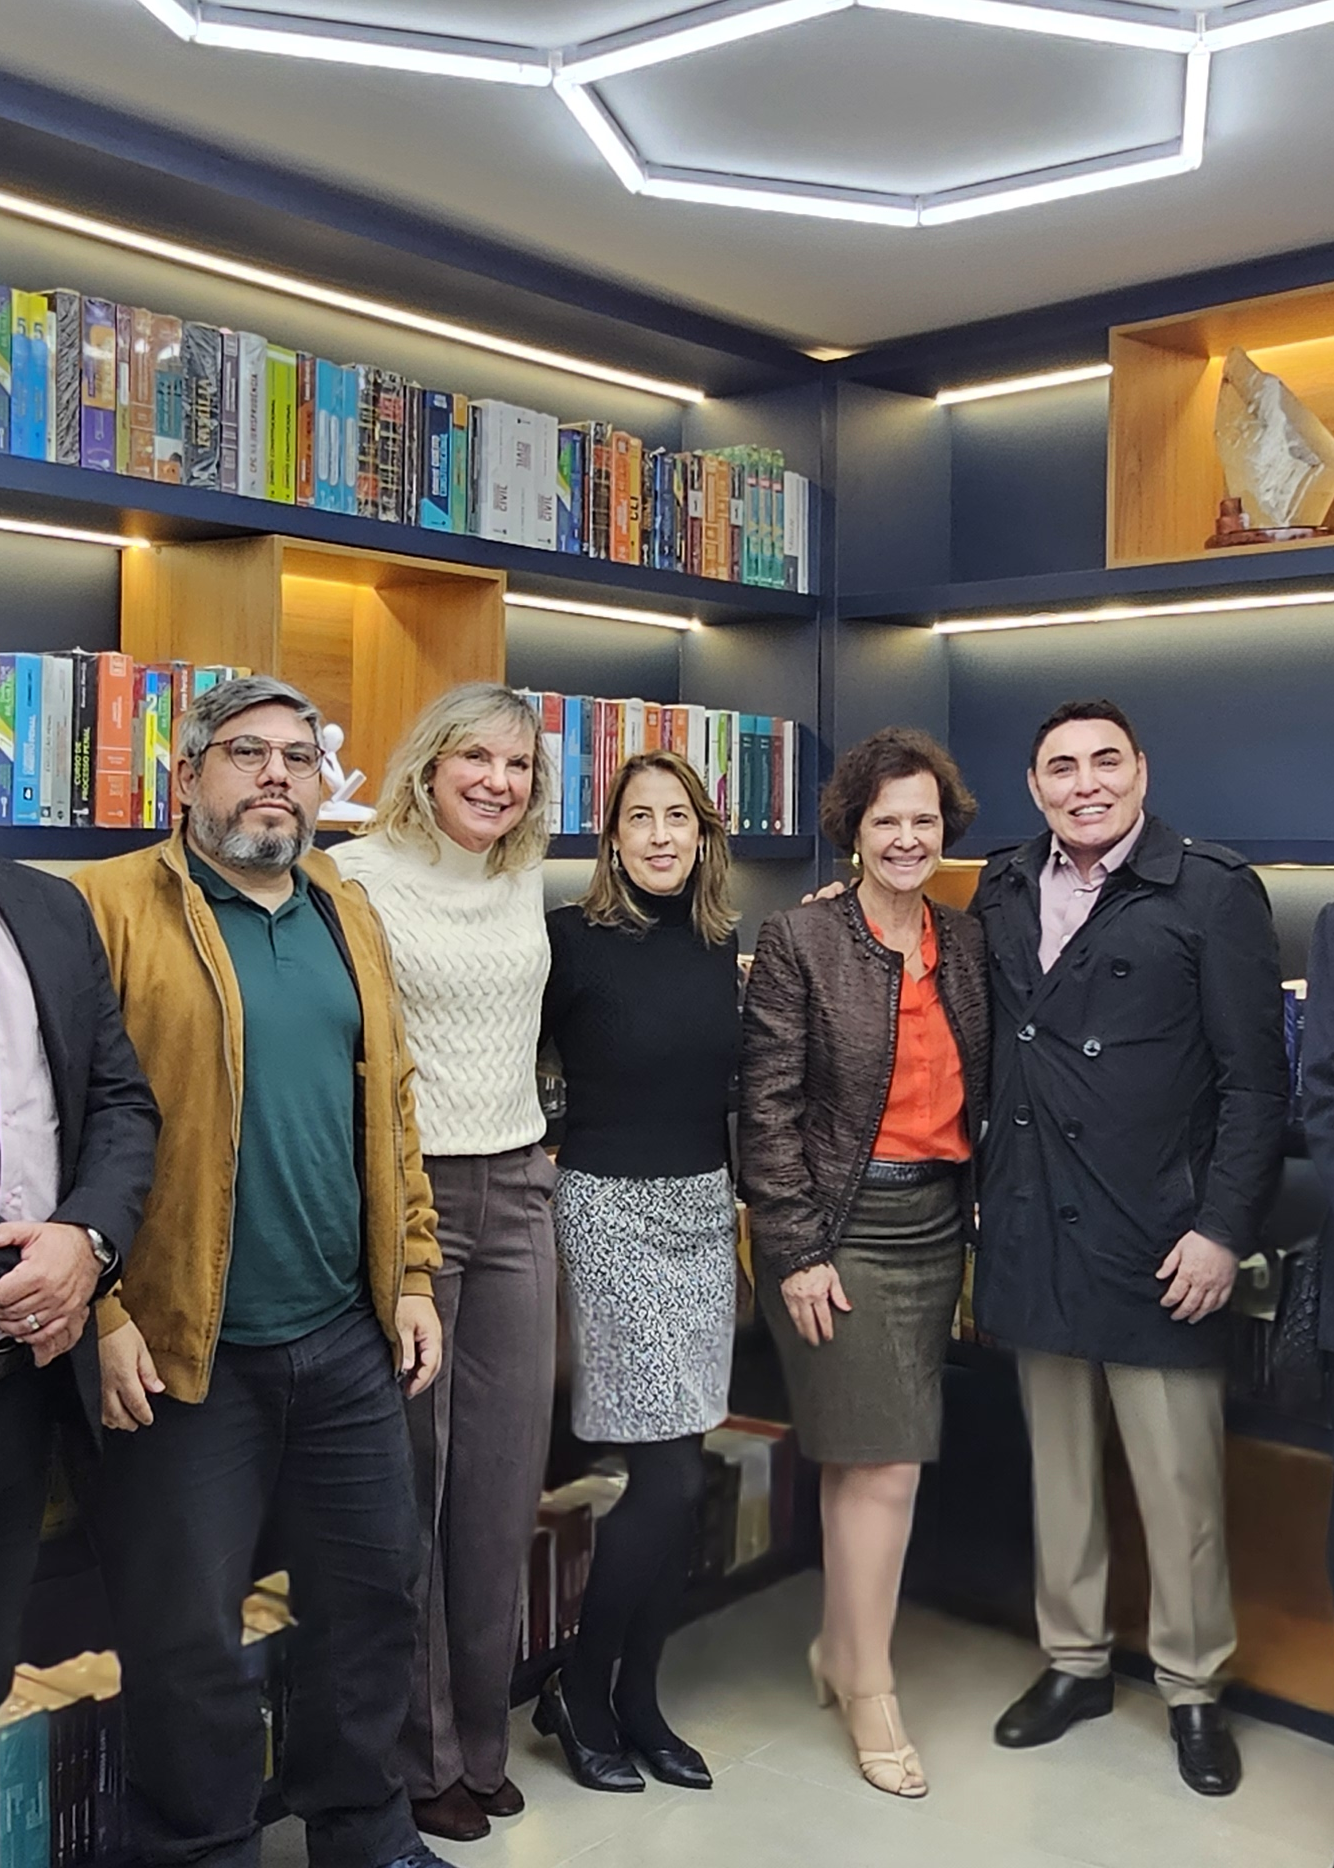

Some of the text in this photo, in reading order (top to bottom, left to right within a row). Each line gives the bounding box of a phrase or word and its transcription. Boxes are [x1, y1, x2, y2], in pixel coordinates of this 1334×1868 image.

[17, 318, 26, 335] 5
[33, 323, 43, 340] 5
[517, 441, 526, 469] CIVIL
[499, 484, 508, 512] CIVIL
[543, 495, 553, 522] CIVIL
[74, 741, 82, 786] CURSO DE
[82, 726, 91, 801] PROCESSO PENAL
